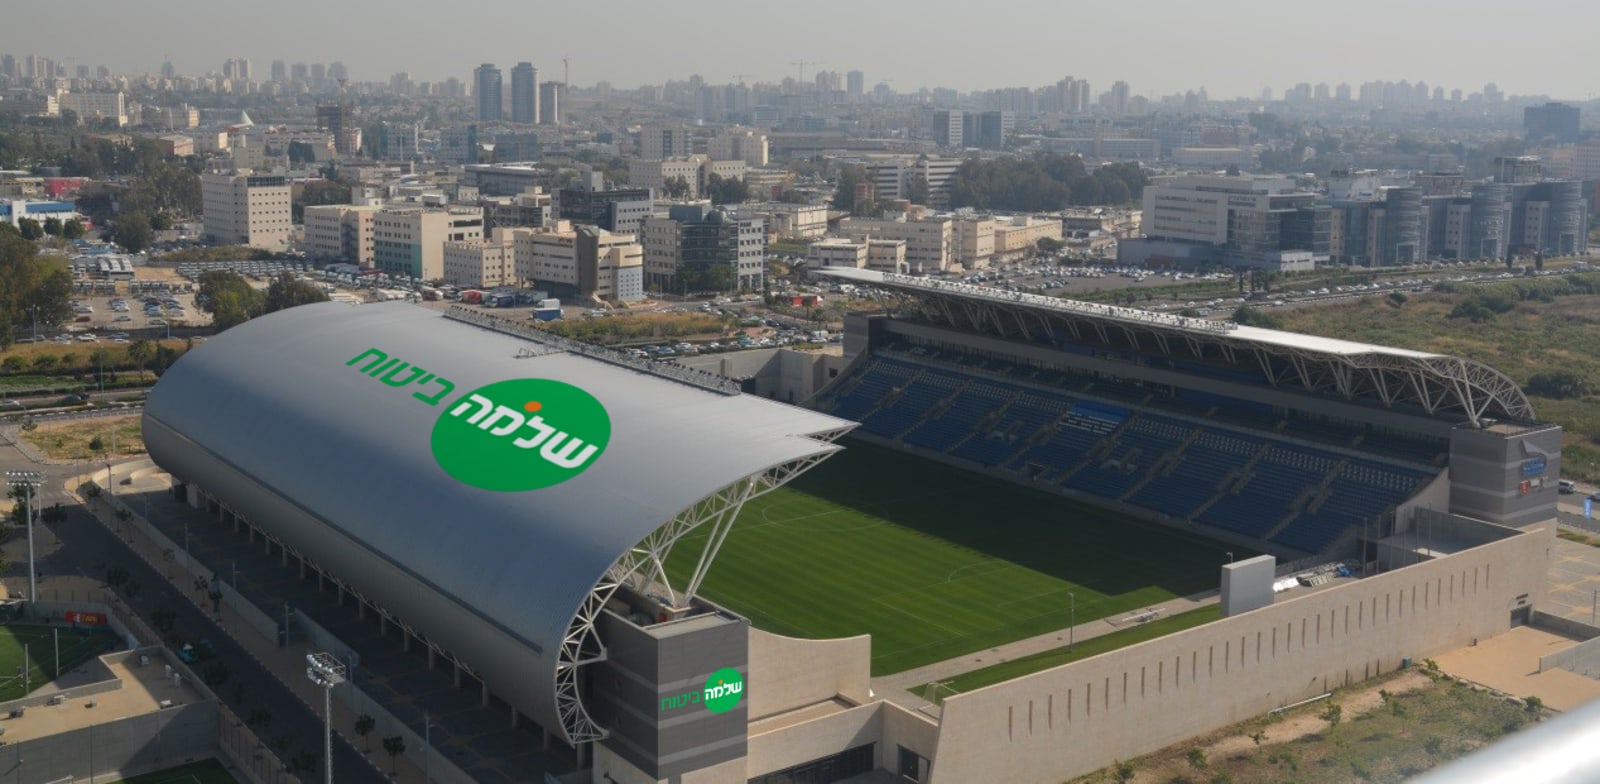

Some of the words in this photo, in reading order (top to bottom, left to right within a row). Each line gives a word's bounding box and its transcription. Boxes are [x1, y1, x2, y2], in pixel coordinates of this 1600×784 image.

[345, 347, 455, 407] ביטוח
[450, 393, 598, 468] שלמה
[661, 691, 700, 712] ביטוח
[704, 681, 742, 700] שלמה
